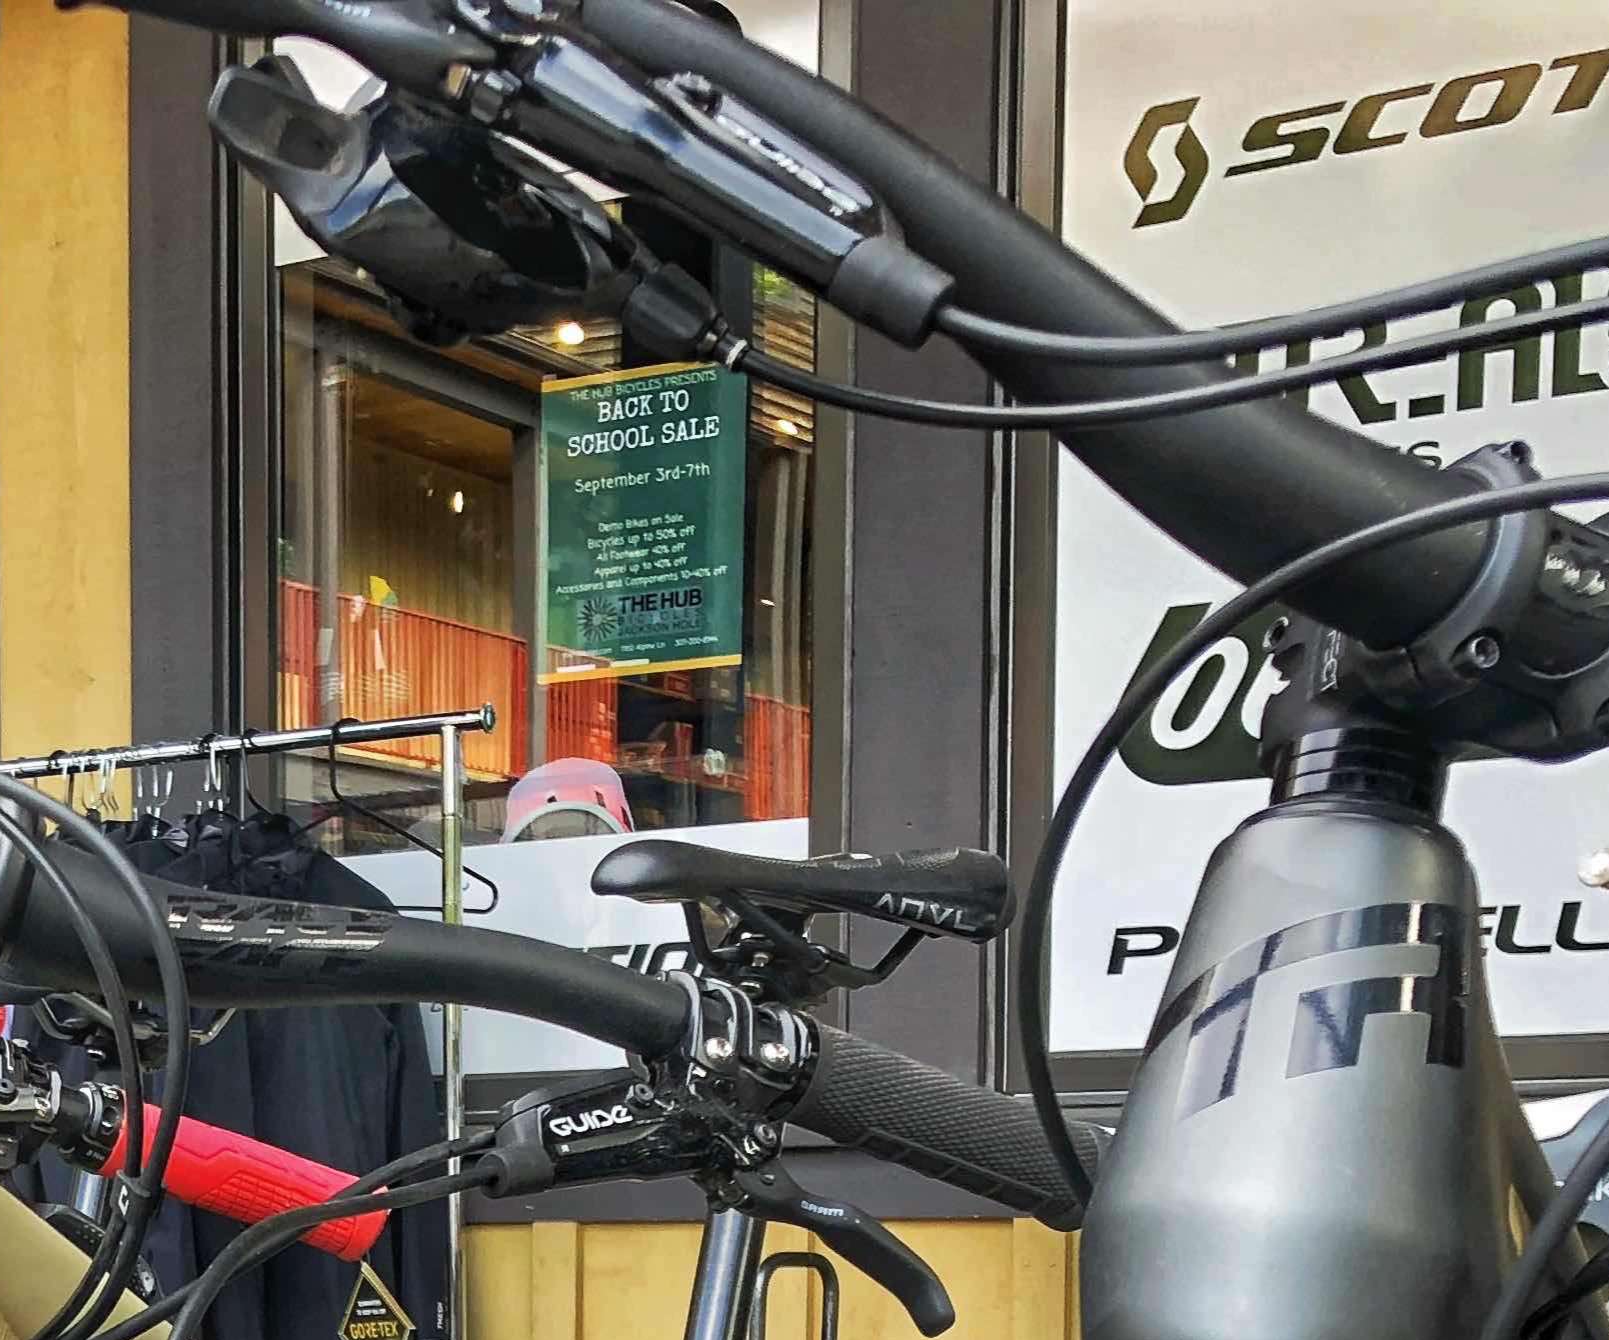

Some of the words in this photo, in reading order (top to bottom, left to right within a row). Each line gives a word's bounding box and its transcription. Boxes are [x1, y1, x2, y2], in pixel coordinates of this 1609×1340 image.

[570, 391, 591, 402] THE
[616, 377, 662, 395] BICYCLES
[597, 394, 653, 423] BACK
[660, 389, 690, 413] TO
[567, 425, 654, 457] SCHOOL
[661, 415, 720, 444] SALE
[574, 471, 652, 496] September
[656, 462, 710, 482] 3rd-7th
[651, 516, 663, 526] on
[587, 536, 625, 550] Bicycles
[628, 534, 641, 546] up
[643, 531, 654, 542] to
[679, 525, 696, 537] off
[671, 542, 687, 553] off
[606, 577, 623, 589] and
[625, 572, 679, 588] Components
[713, 565, 729, 577] off
[629, 563, 640, 574] up
[642, 561, 652, 570] to
[673, 556, 689, 567] off
[618, 593, 658, 614] THE
[660, 588, 703, 610] HUB
[548, 1103, 633, 1137] GUIDE
[349, 1320, 400, 1340] GORE-TEX
